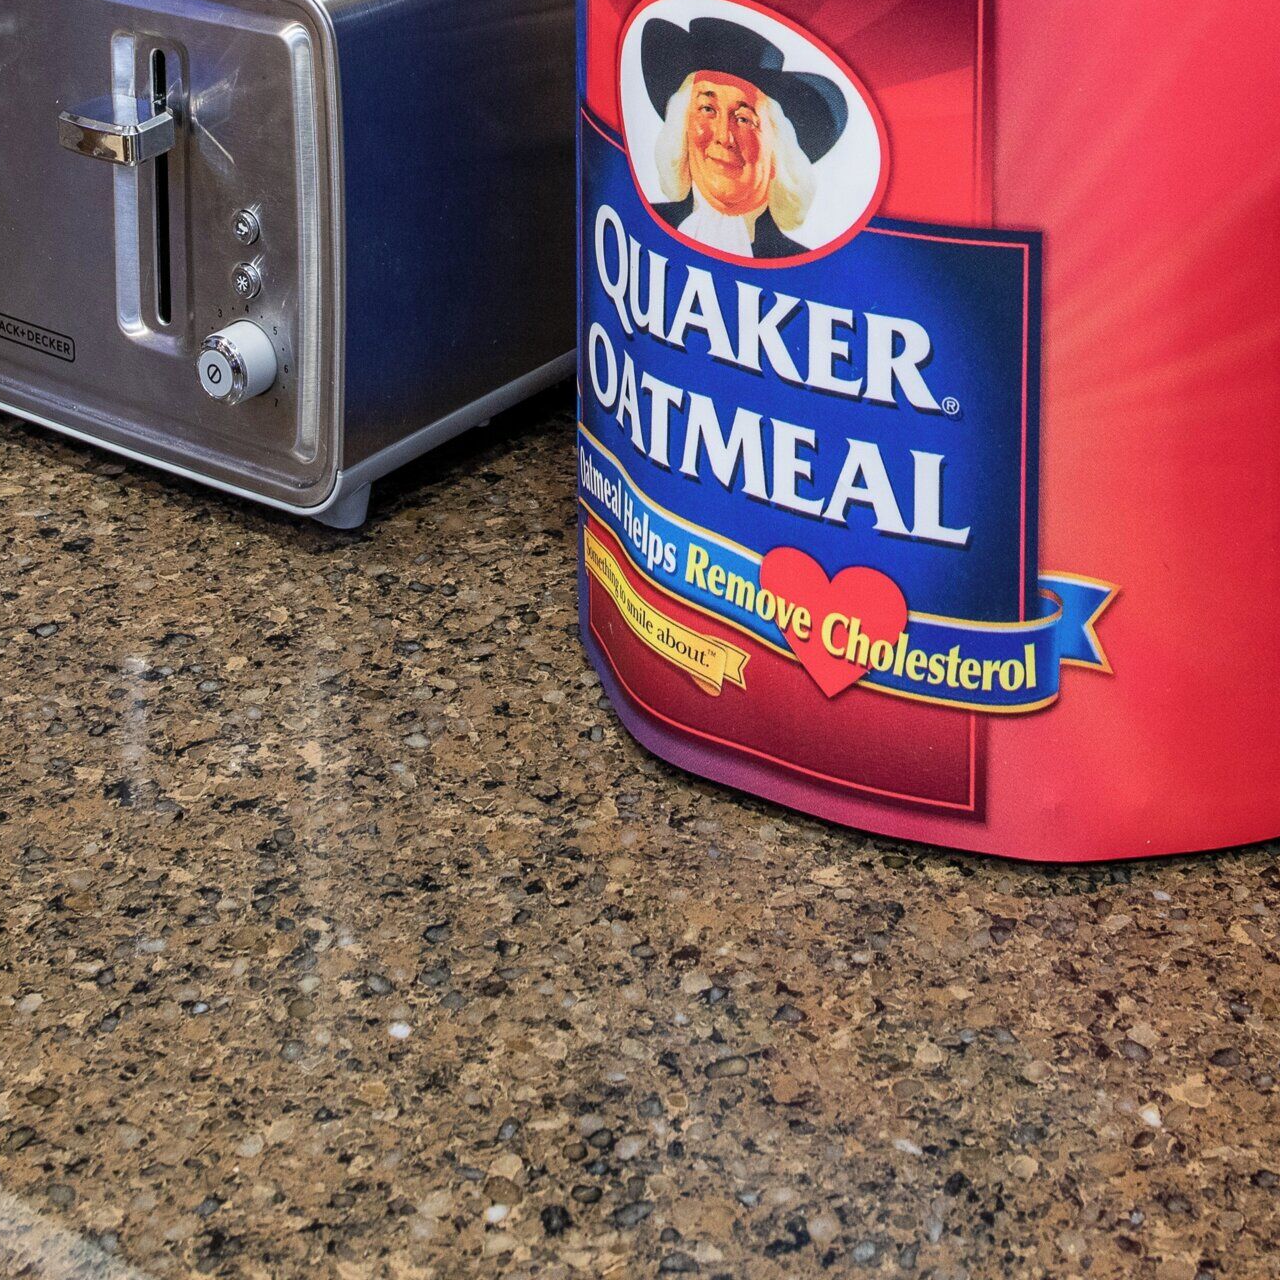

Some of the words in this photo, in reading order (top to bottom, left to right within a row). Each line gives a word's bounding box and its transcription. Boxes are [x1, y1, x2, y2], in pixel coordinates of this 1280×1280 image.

[588, 322, 970, 545] OATMEAL
[579, 445, 622, 520] Oatmeal
[624, 489, 677, 573] Helps
[684, 542, 812, 640] Remove
[821, 612, 1037, 691] Cholesterol
[585, 537, 620, 600] Something
[619, 584, 626, 605] to
[626, 598, 654, 635] smile
